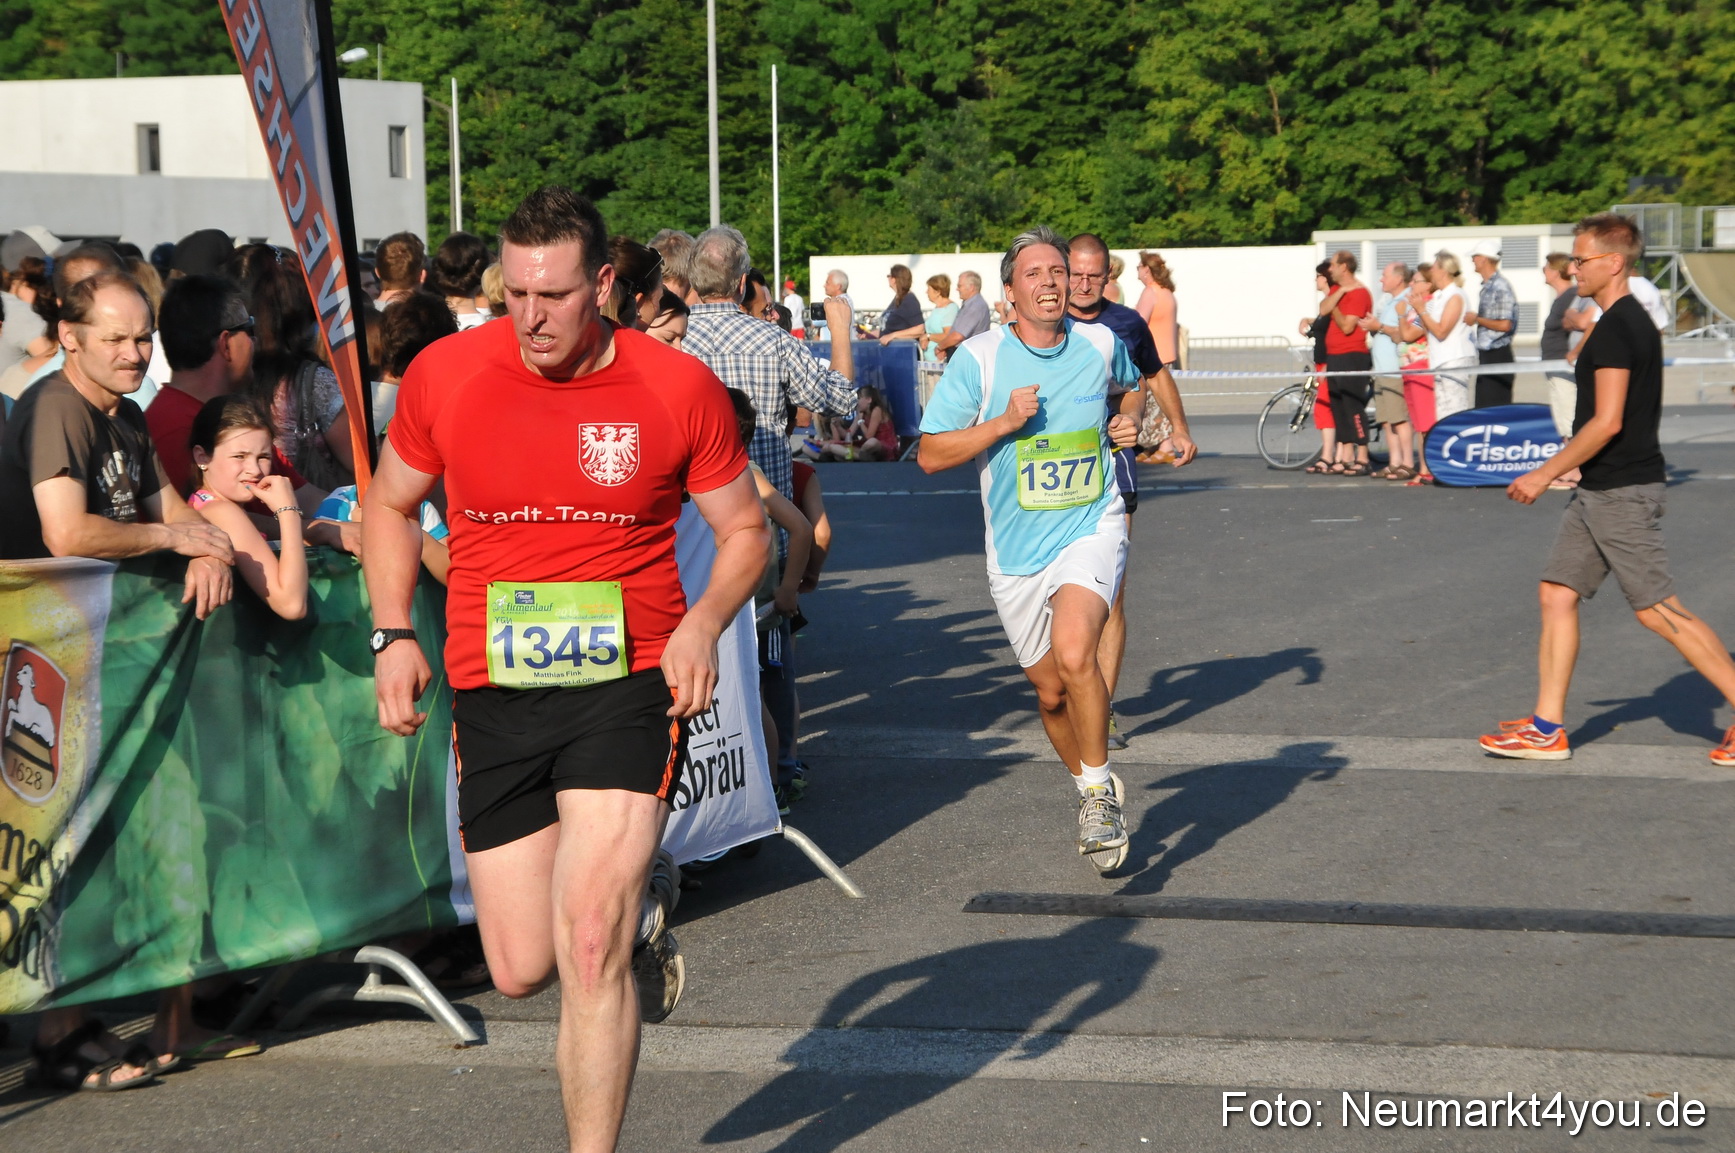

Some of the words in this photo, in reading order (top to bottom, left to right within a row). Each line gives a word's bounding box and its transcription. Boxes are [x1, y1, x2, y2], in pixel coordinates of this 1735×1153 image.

[1021, 455, 1097, 491] 1377
[506, 603, 553, 612] firmenlauf
[493, 625, 619, 669] 1345
[10, 758, 43, 790] 1628
